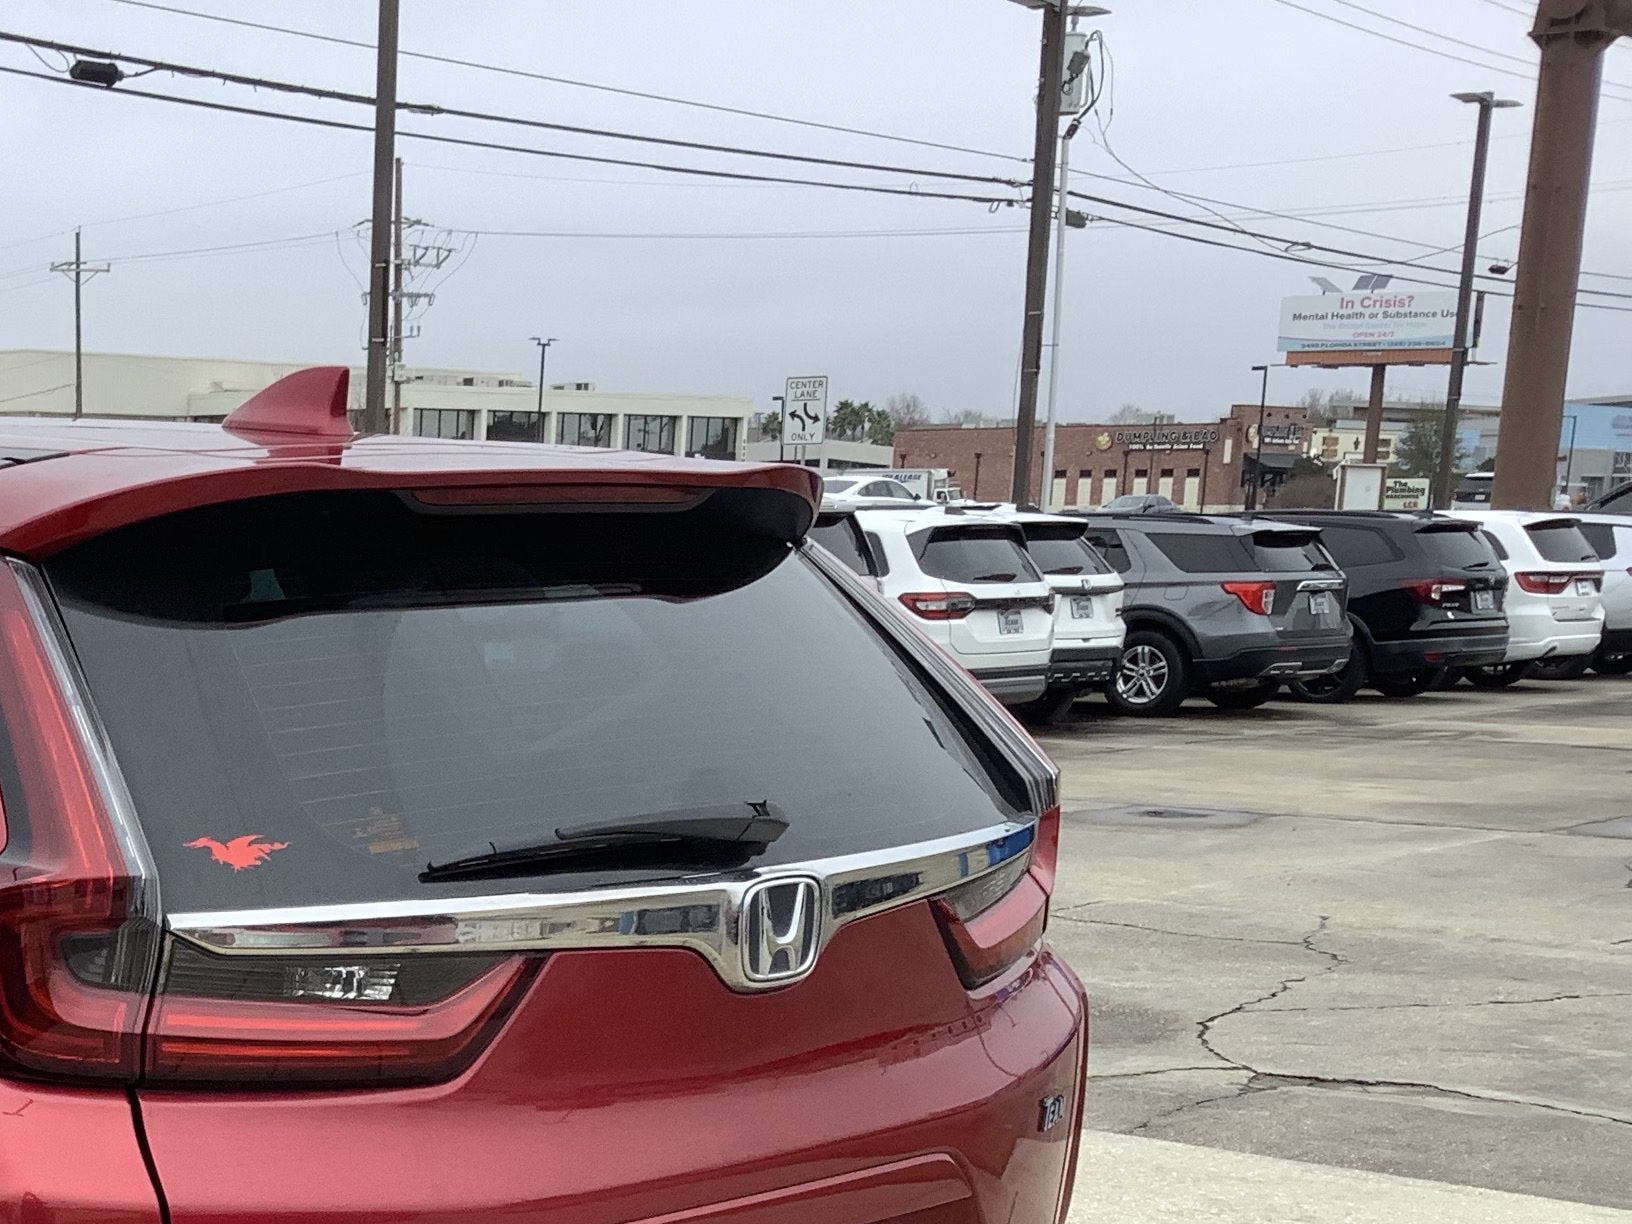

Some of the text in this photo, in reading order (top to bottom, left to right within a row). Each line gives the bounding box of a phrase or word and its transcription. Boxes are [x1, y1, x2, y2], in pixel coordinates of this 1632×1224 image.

[1339, 295, 1415, 310] In Crisis?
[1292, 312, 1329, 322] Mental
[1331, 311, 1366, 321] Health
[1368, 312, 1380, 320] or
[1382, 310, 1438, 320] Substance
[1352, 331, 1375, 339] OPEN
[789, 380, 824, 390] CENTER
[794, 389, 818, 399] LANE
[791, 432, 816, 441] ONLY
[1116, 430, 1179, 443] DUMPLING
[1181, 431, 1192, 442] &
[1393, 480, 1408, 488] The
[1386, 485, 1426, 496] Plumbing
